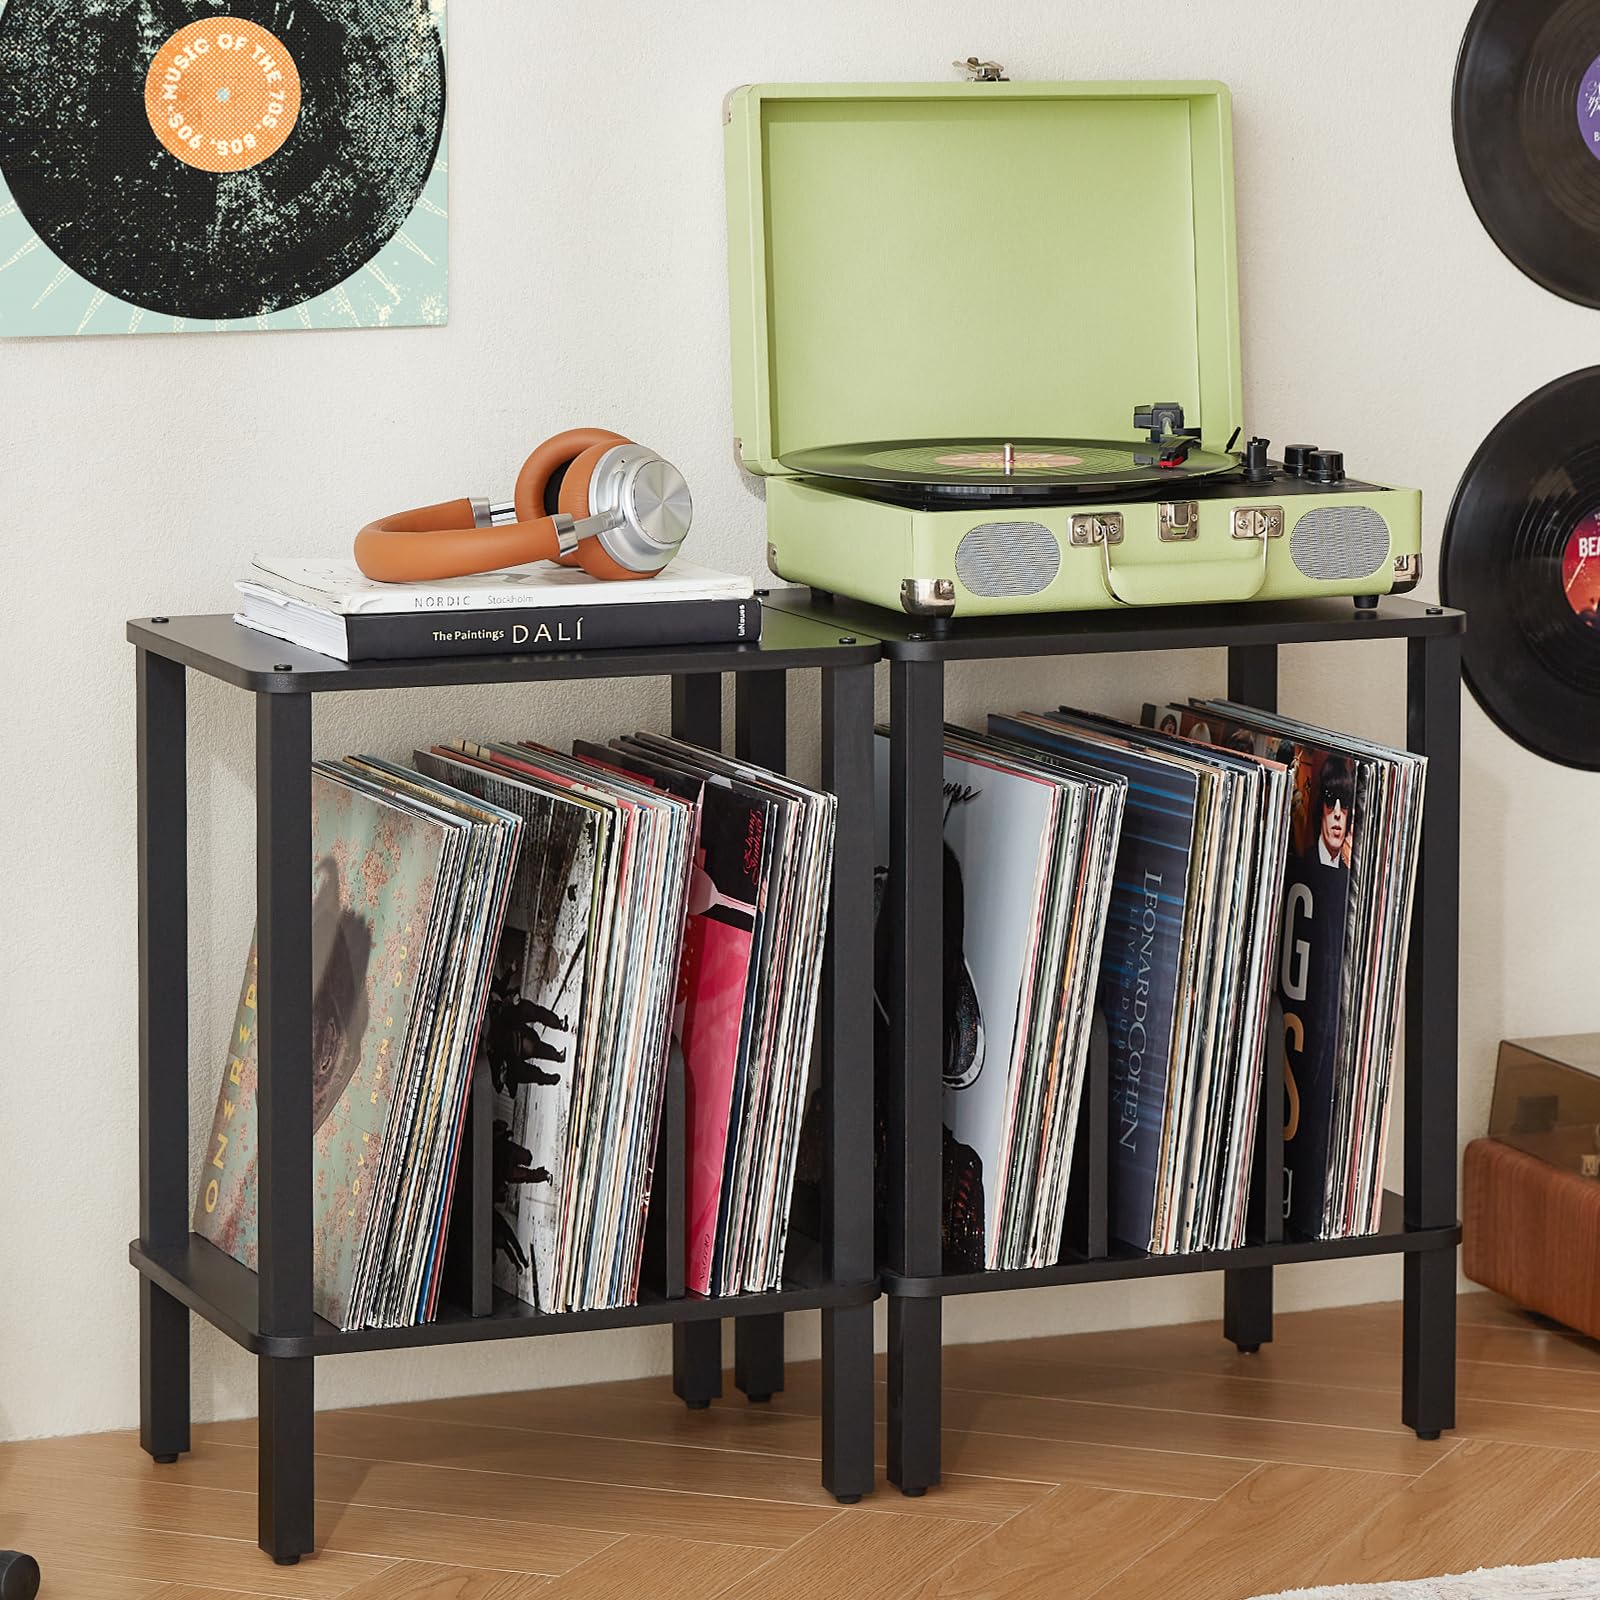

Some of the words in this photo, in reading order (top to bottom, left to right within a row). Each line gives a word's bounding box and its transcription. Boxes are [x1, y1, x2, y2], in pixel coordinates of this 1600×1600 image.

[162, 38, 210, 100] MUSIC
[217, 33, 247, 51] OF
[251, 44, 284, 84] THE
[414, 596, 471, 608] NORDIC
[487, 594, 534, 605] Stockholm
[432, 631, 453, 641] The
[454, 629, 505, 642] Paintings
[512, 616, 584, 644] DALÍ
[348, 1131, 370, 1217] LOVE
[369, 1015, 394, 1105] RUNS
